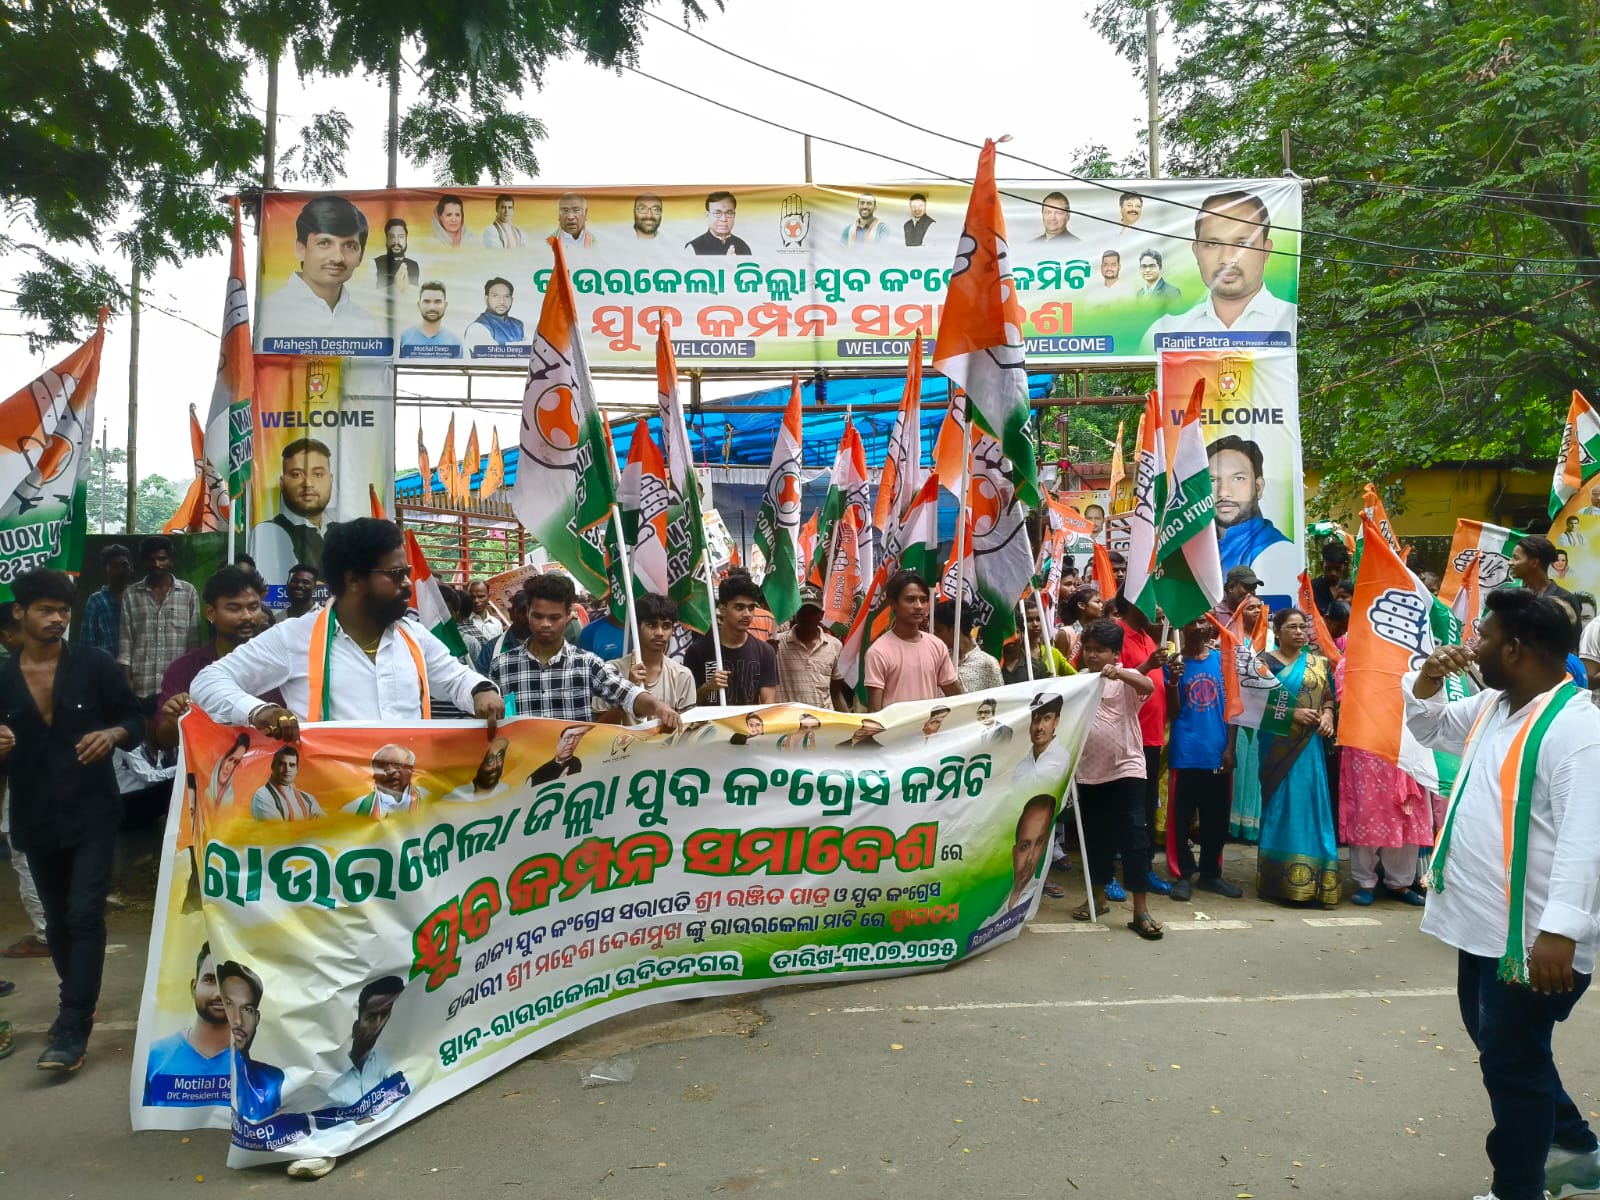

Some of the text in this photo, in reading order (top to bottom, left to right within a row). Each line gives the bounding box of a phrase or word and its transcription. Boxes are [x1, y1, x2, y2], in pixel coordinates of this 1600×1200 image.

[733, 262, 806, 302] ଜିଲ୍ଲା
[814, 267, 871, 302] ଯୁବ
[696, 301, 838, 337] କମ୍ପନ
[273, 338, 383, 350] Mahesh Deshmukh
[1162, 335, 1230, 349] Ranjit Patra
[261, 410, 375, 428] WELCOME
[203, 753, 992, 909] ରାଉରକେଲା ଜିଲ୍ଲା ଯୁବ କଂଗ୍ରେସ କମିଟି
[409, 821, 963, 992] ଯୁବ କମ୍ପନ ସମାବେଶ ରେ
[474, 881, 941, 972] ରାଜ୍ୟ ଯୁବ କଂଗ୍ରେସ ସଭାପତି ଶ୍ରୀ ରଞ୍ଜିତ ପାତ୍ର ଓ ଯୁବ କଂଗ୍ରେସ
[446, 973, 503, 1021] ପ୍ରଭାରୀ
[506, 960, 531, 992] ଶ୍ରୀ
[535, 938, 595, 977] ମହେଶ
[599, 921, 682, 954] ଦେଶମୁଖ
[710, 914, 820, 935] ରାଉରକେଲା
[822, 909, 858, 930] ମାଟି
[860, 912, 886, 928] ରେ
[615, 954, 740, 986] ଉଦିତନଗର
[166, 1091, 181, 1100] DYC
[182, 1091, 219, 1101] President
[174, 1077, 215, 1090] Motilal
[243, 1124, 276, 1140] Deep
